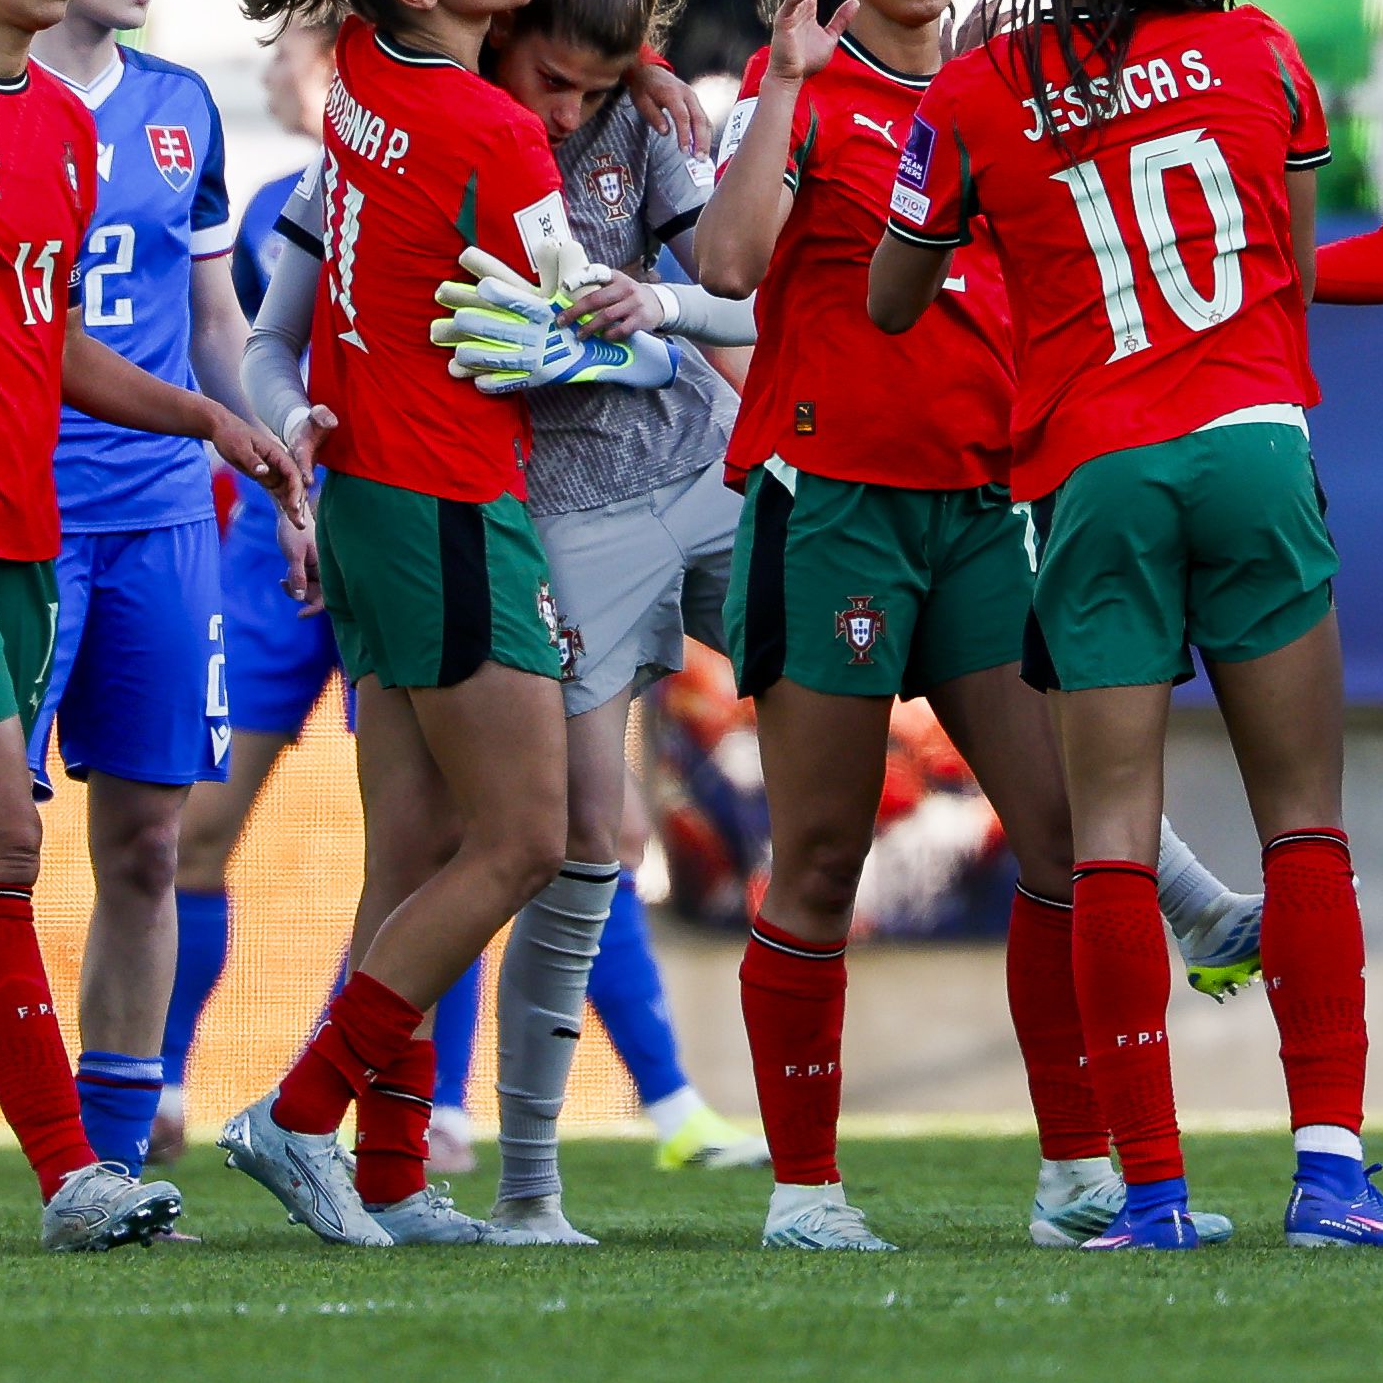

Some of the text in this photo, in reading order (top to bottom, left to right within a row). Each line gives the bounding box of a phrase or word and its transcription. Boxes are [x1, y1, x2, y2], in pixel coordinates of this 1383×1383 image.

[1181, 49, 1222, 91] S.
[381, 127, 405, 175] P.
[14, 240, 63, 325] 15
[84, 223, 136, 326] 2
[1049, 128, 1247, 365] 10
